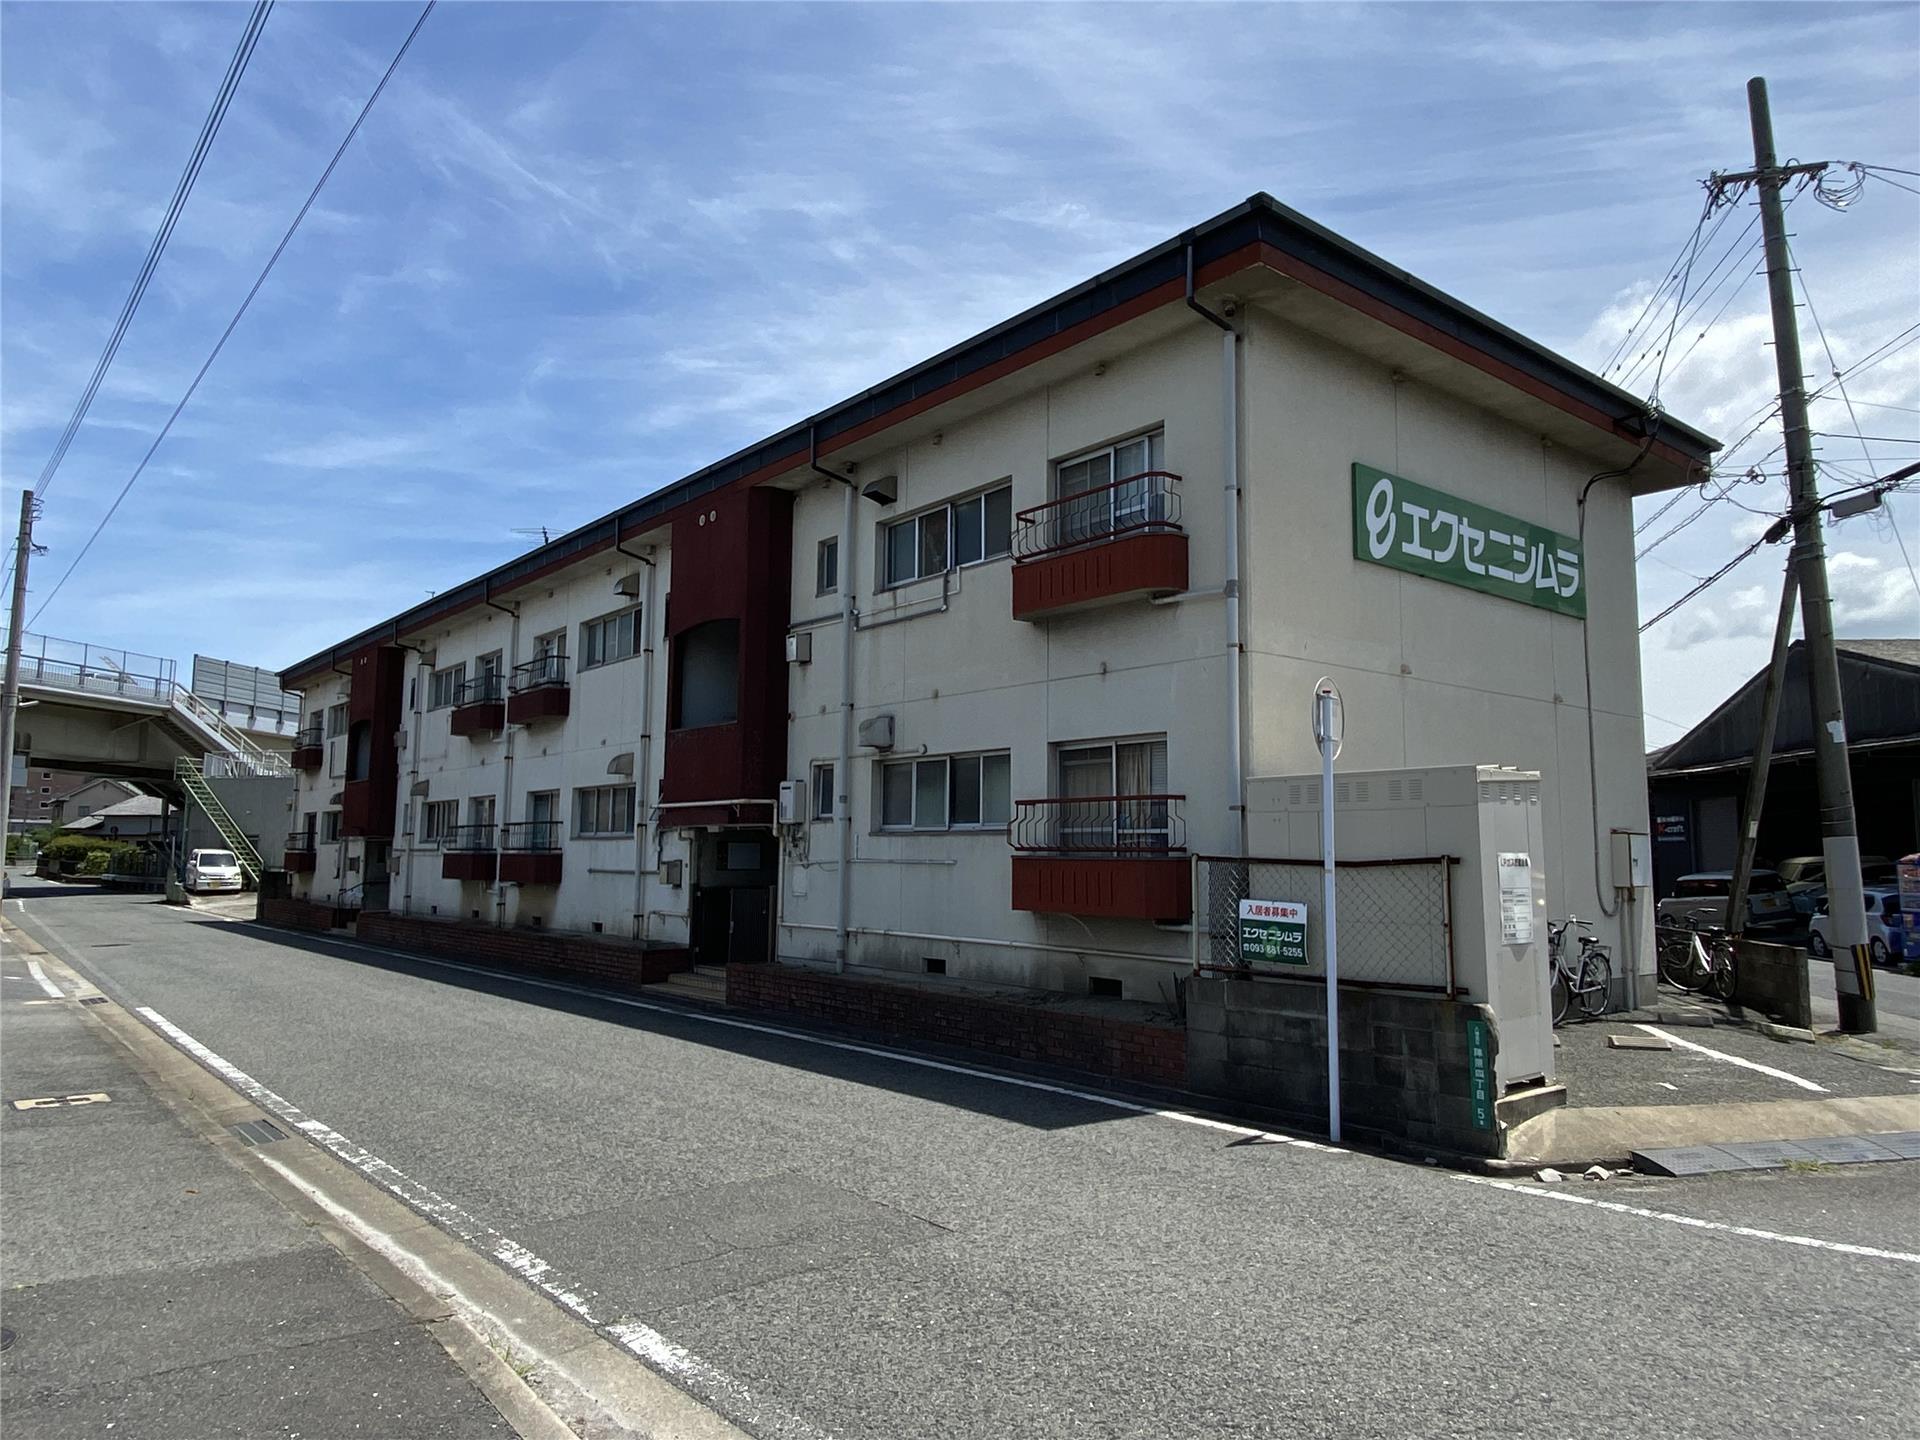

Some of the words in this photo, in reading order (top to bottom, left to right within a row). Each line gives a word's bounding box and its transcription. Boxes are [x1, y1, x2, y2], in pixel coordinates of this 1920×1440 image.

[1402, 501, 1580, 598] エクセニシムラ
[1247, 904, 1298, 918] 入居者募集中
[1243, 927, 1303, 943] エクセニシムラ
